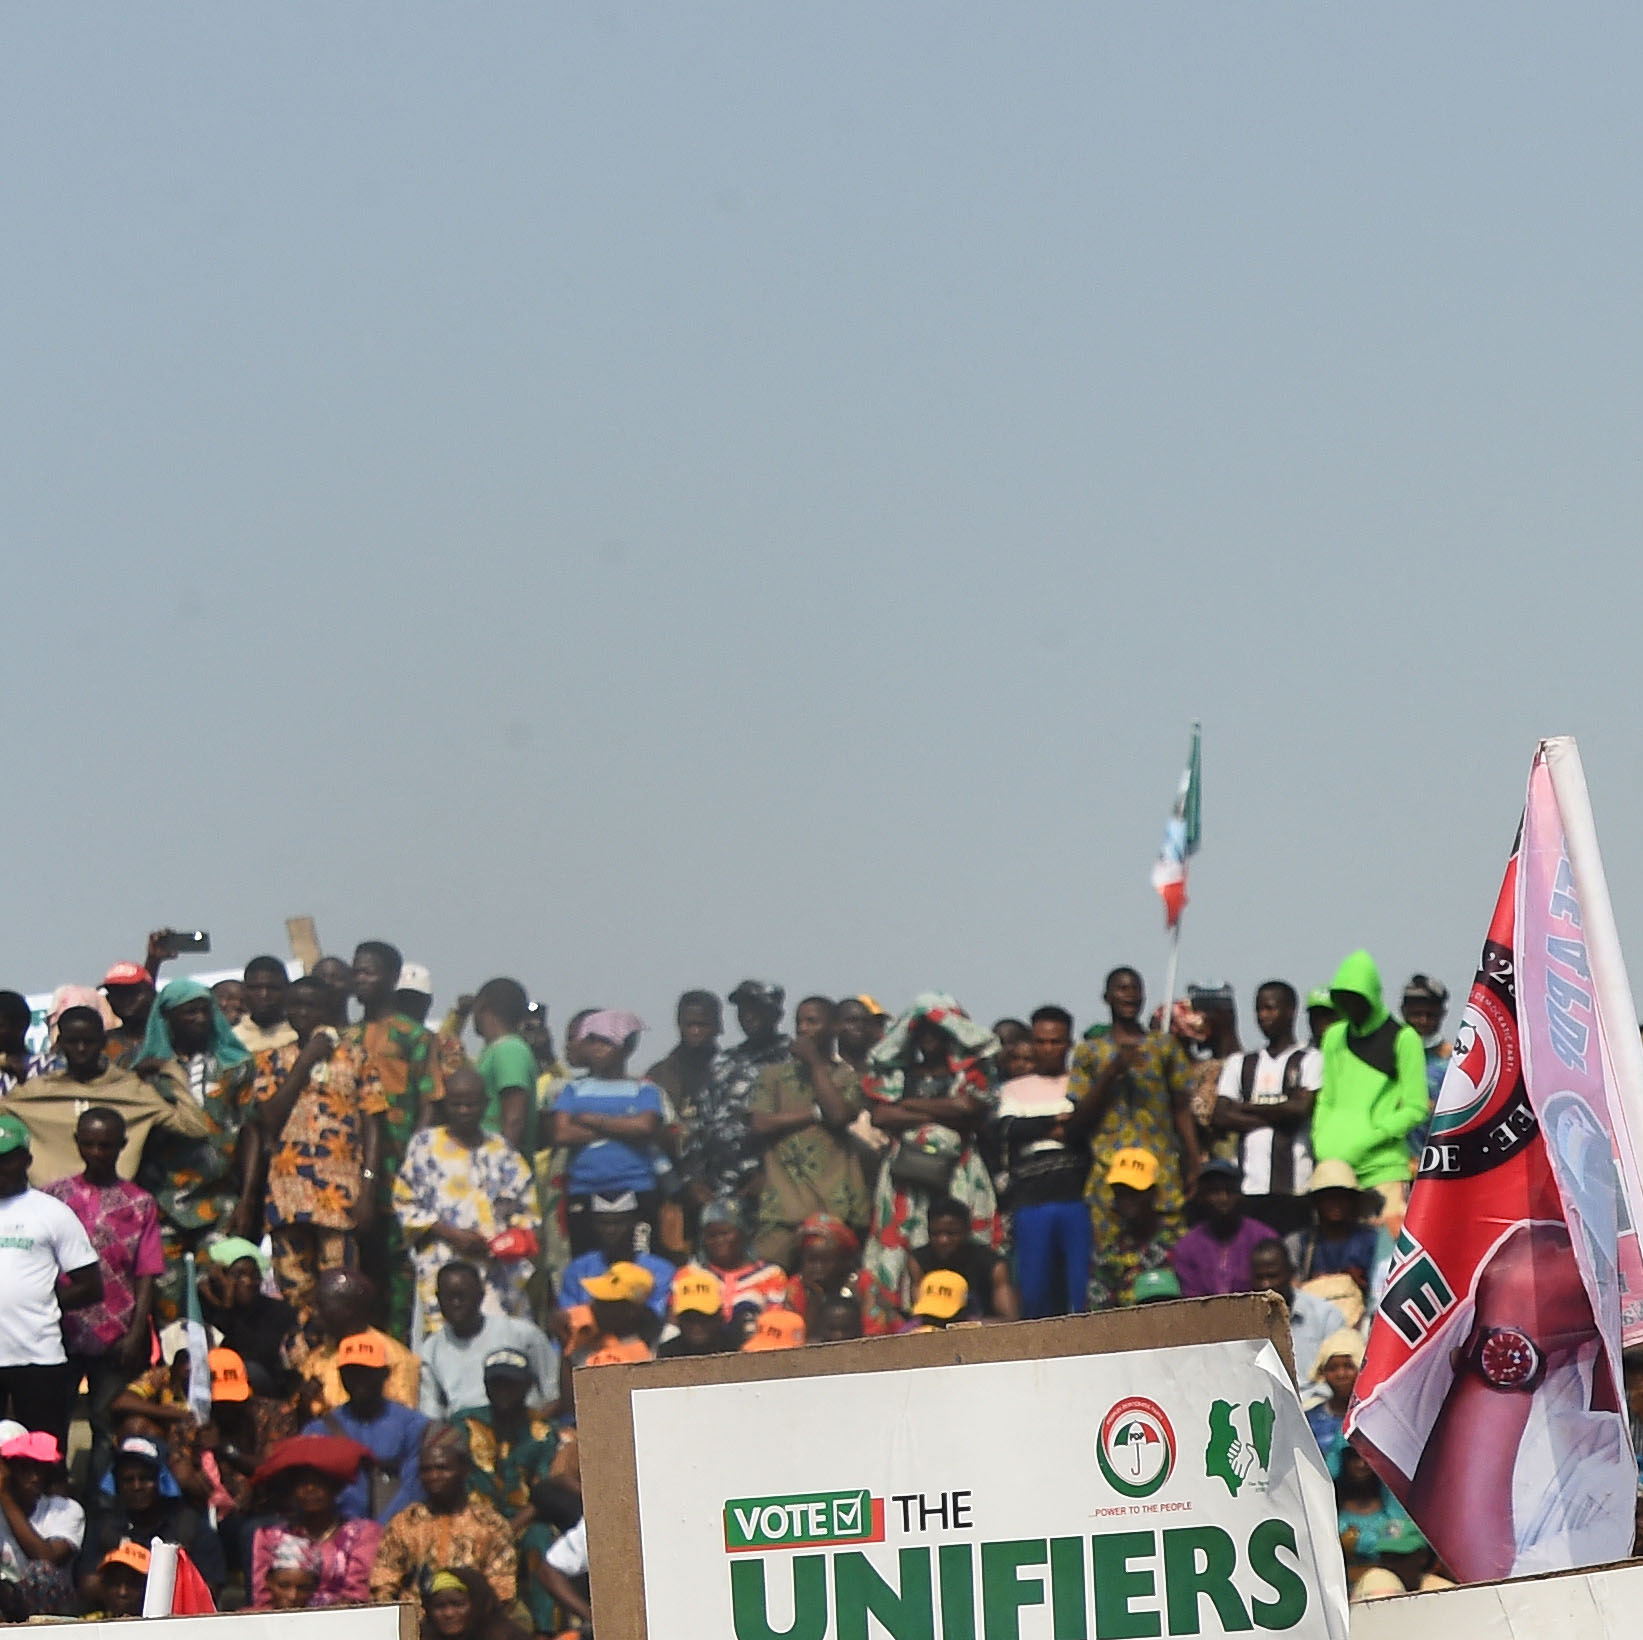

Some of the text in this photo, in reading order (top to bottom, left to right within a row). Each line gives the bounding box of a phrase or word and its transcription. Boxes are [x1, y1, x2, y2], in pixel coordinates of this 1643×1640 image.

[1129, 1431, 1145, 1441] PDP
[734, 1491, 972, 1540] VOTE THE
